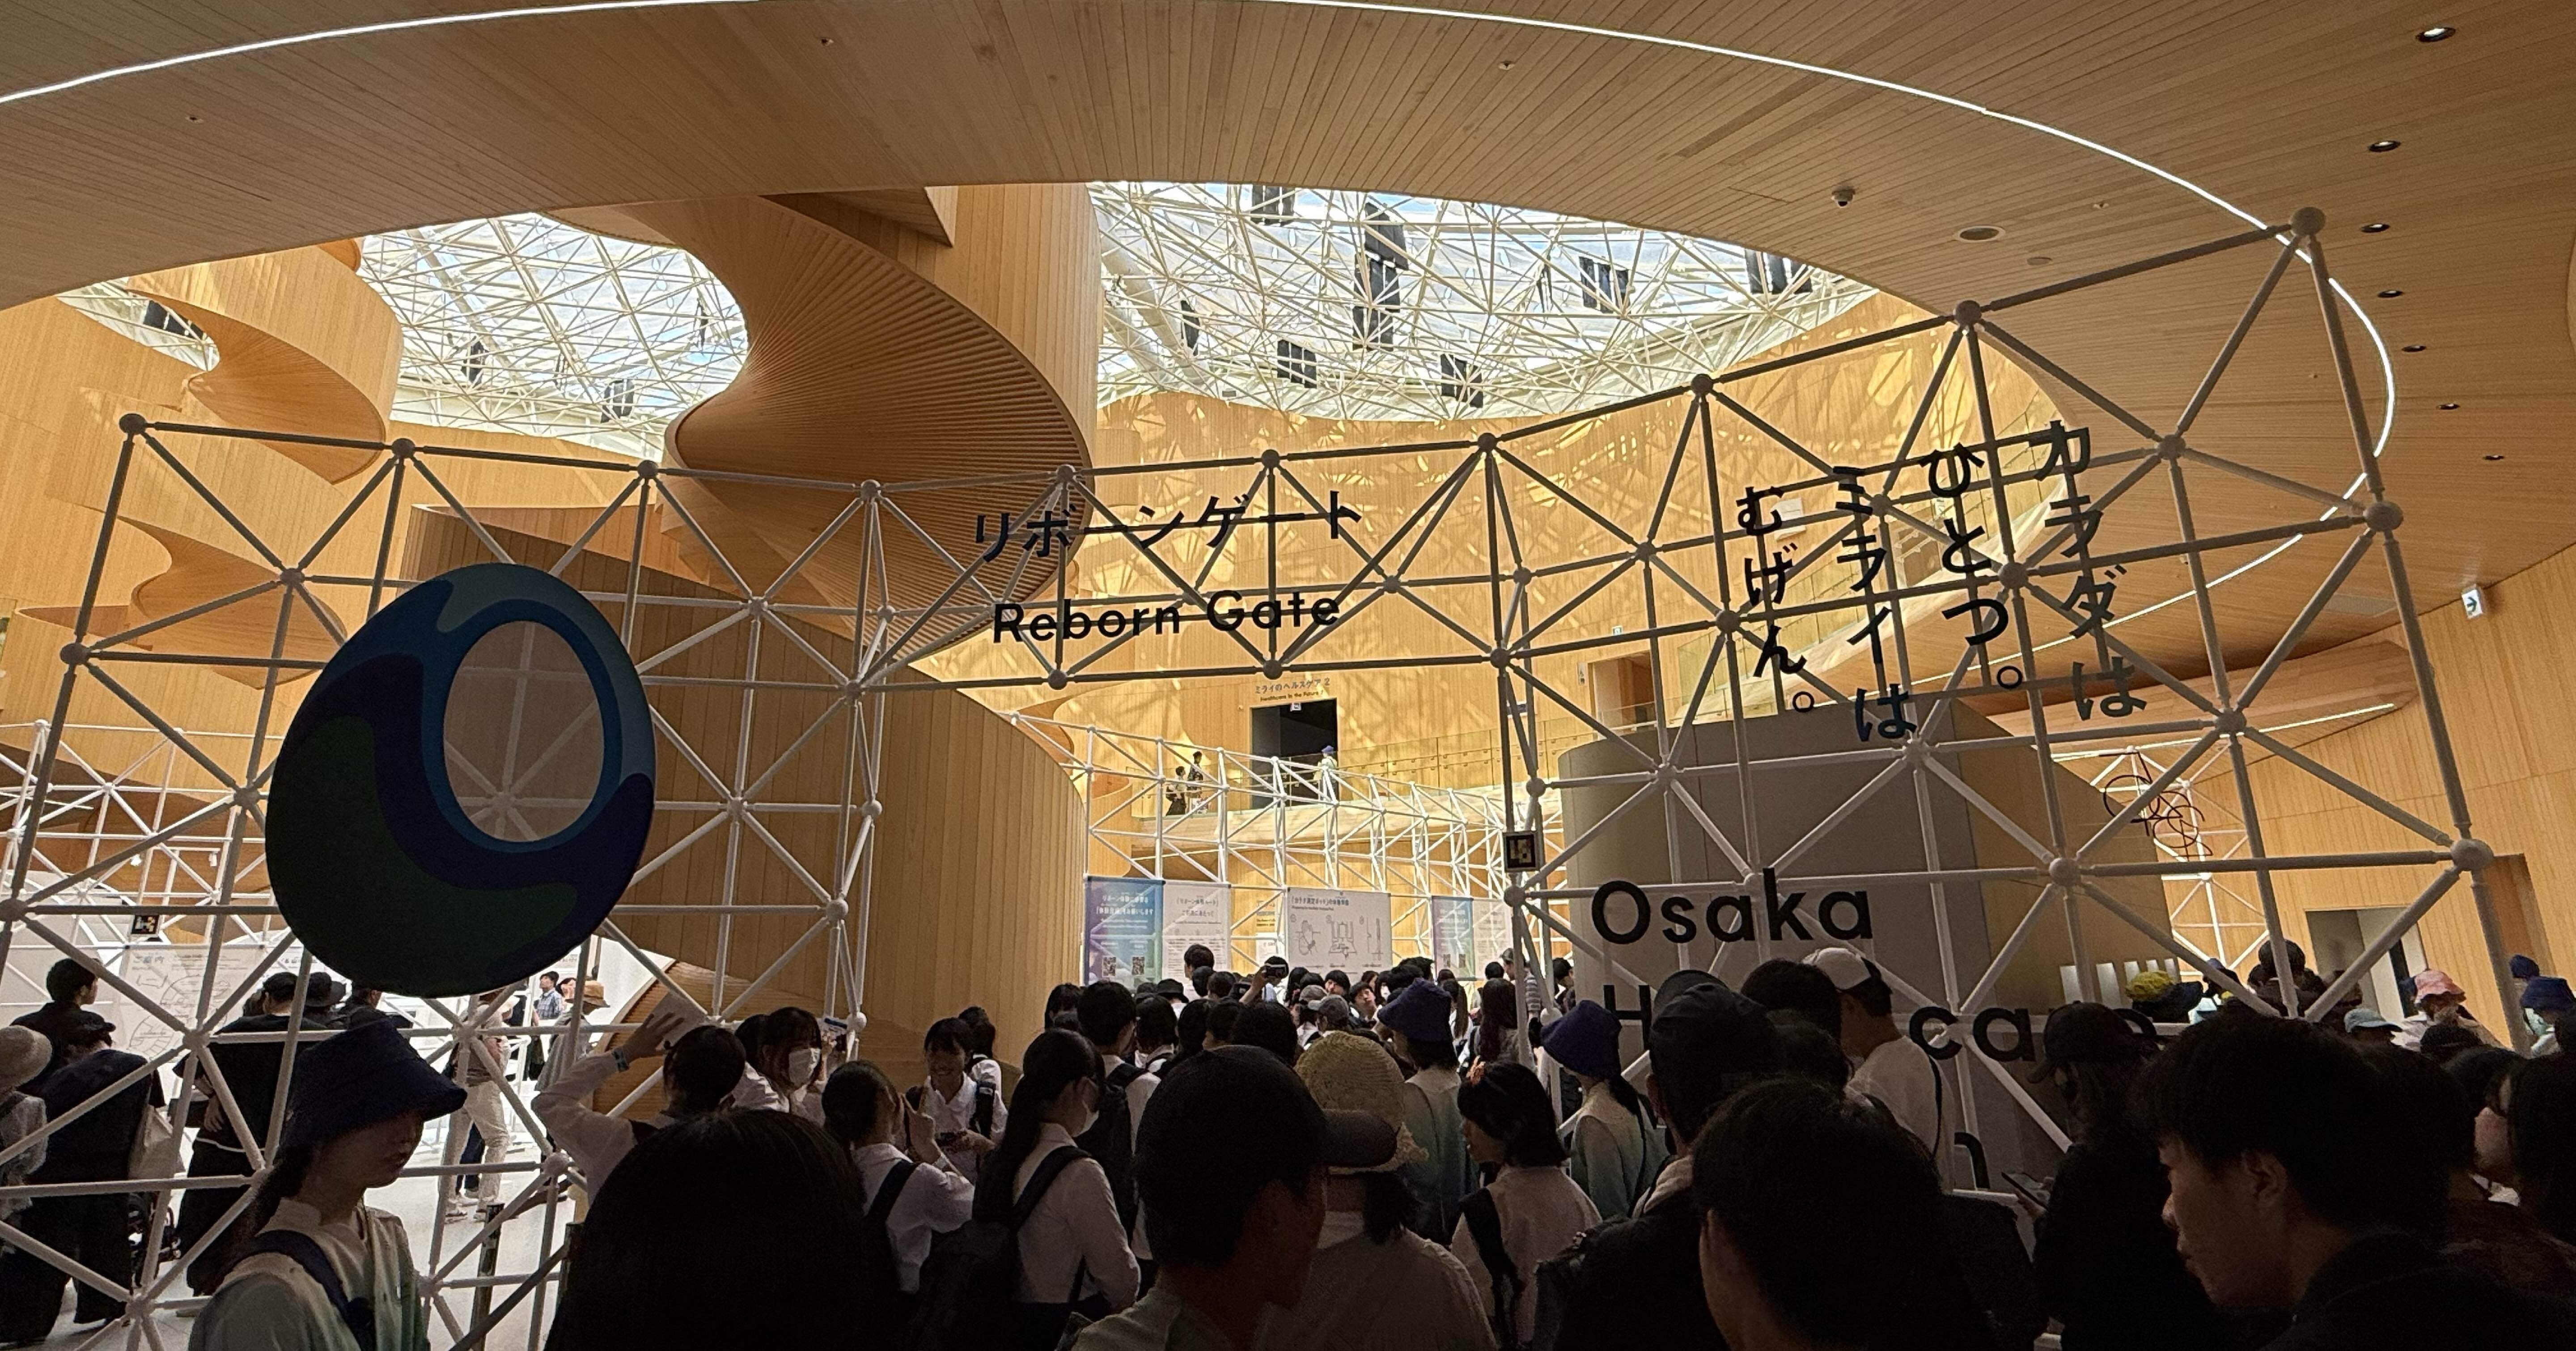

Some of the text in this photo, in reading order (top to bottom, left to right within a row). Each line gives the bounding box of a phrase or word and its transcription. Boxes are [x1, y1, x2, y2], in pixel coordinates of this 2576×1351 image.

[975, 490, 1362, 562] リボーンゲート
[993, 590, 1340, 643] Reborn Gate
[1737, 486, 1815, 713] むげん。
[1833, 466, 1917, 742] ミライは
[1919, 442, 2023, 689] ひとつ。
[2029, 420, 2147, 721] カラダは
[1591, 867, 1873, 944] Osaka
